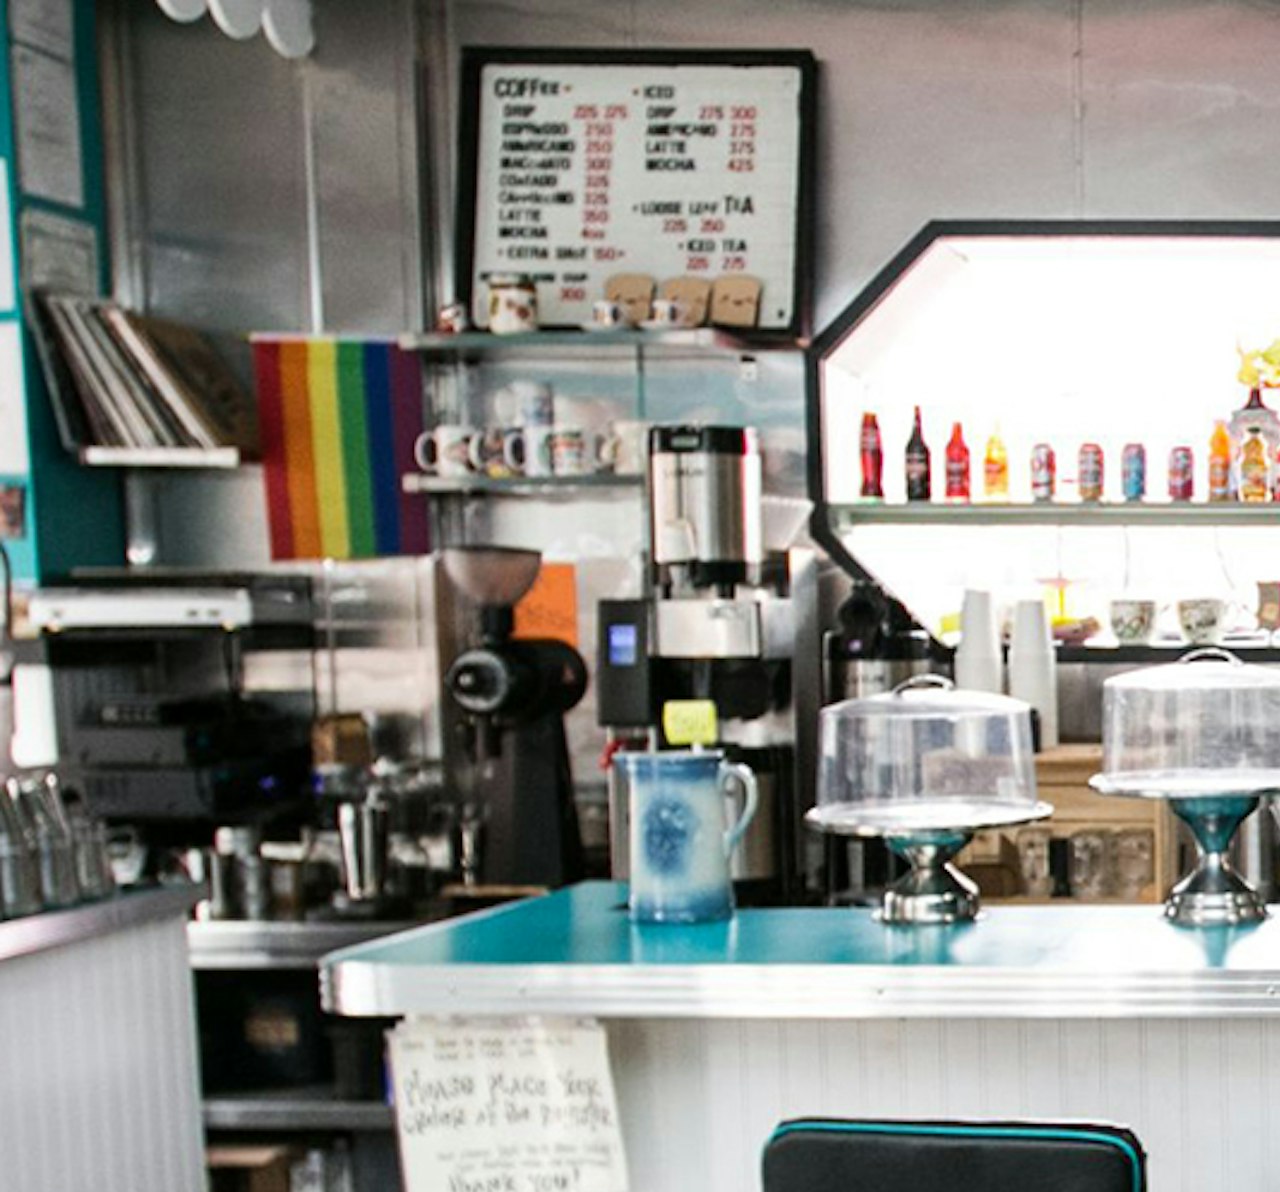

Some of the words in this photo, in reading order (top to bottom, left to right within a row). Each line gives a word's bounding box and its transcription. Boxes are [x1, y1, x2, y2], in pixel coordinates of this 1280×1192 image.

[646, 141, 685, 153] LATTE
[646, 159, 695, 171] MOCHA
[727, 158, 754, 172] 425
[641, 202, 681, 215] LOOSE
[499, 209, 541, 222] LATTE
[499, 226, 547, 238] MOCHA
[723, 240, 747, 252] TEA
